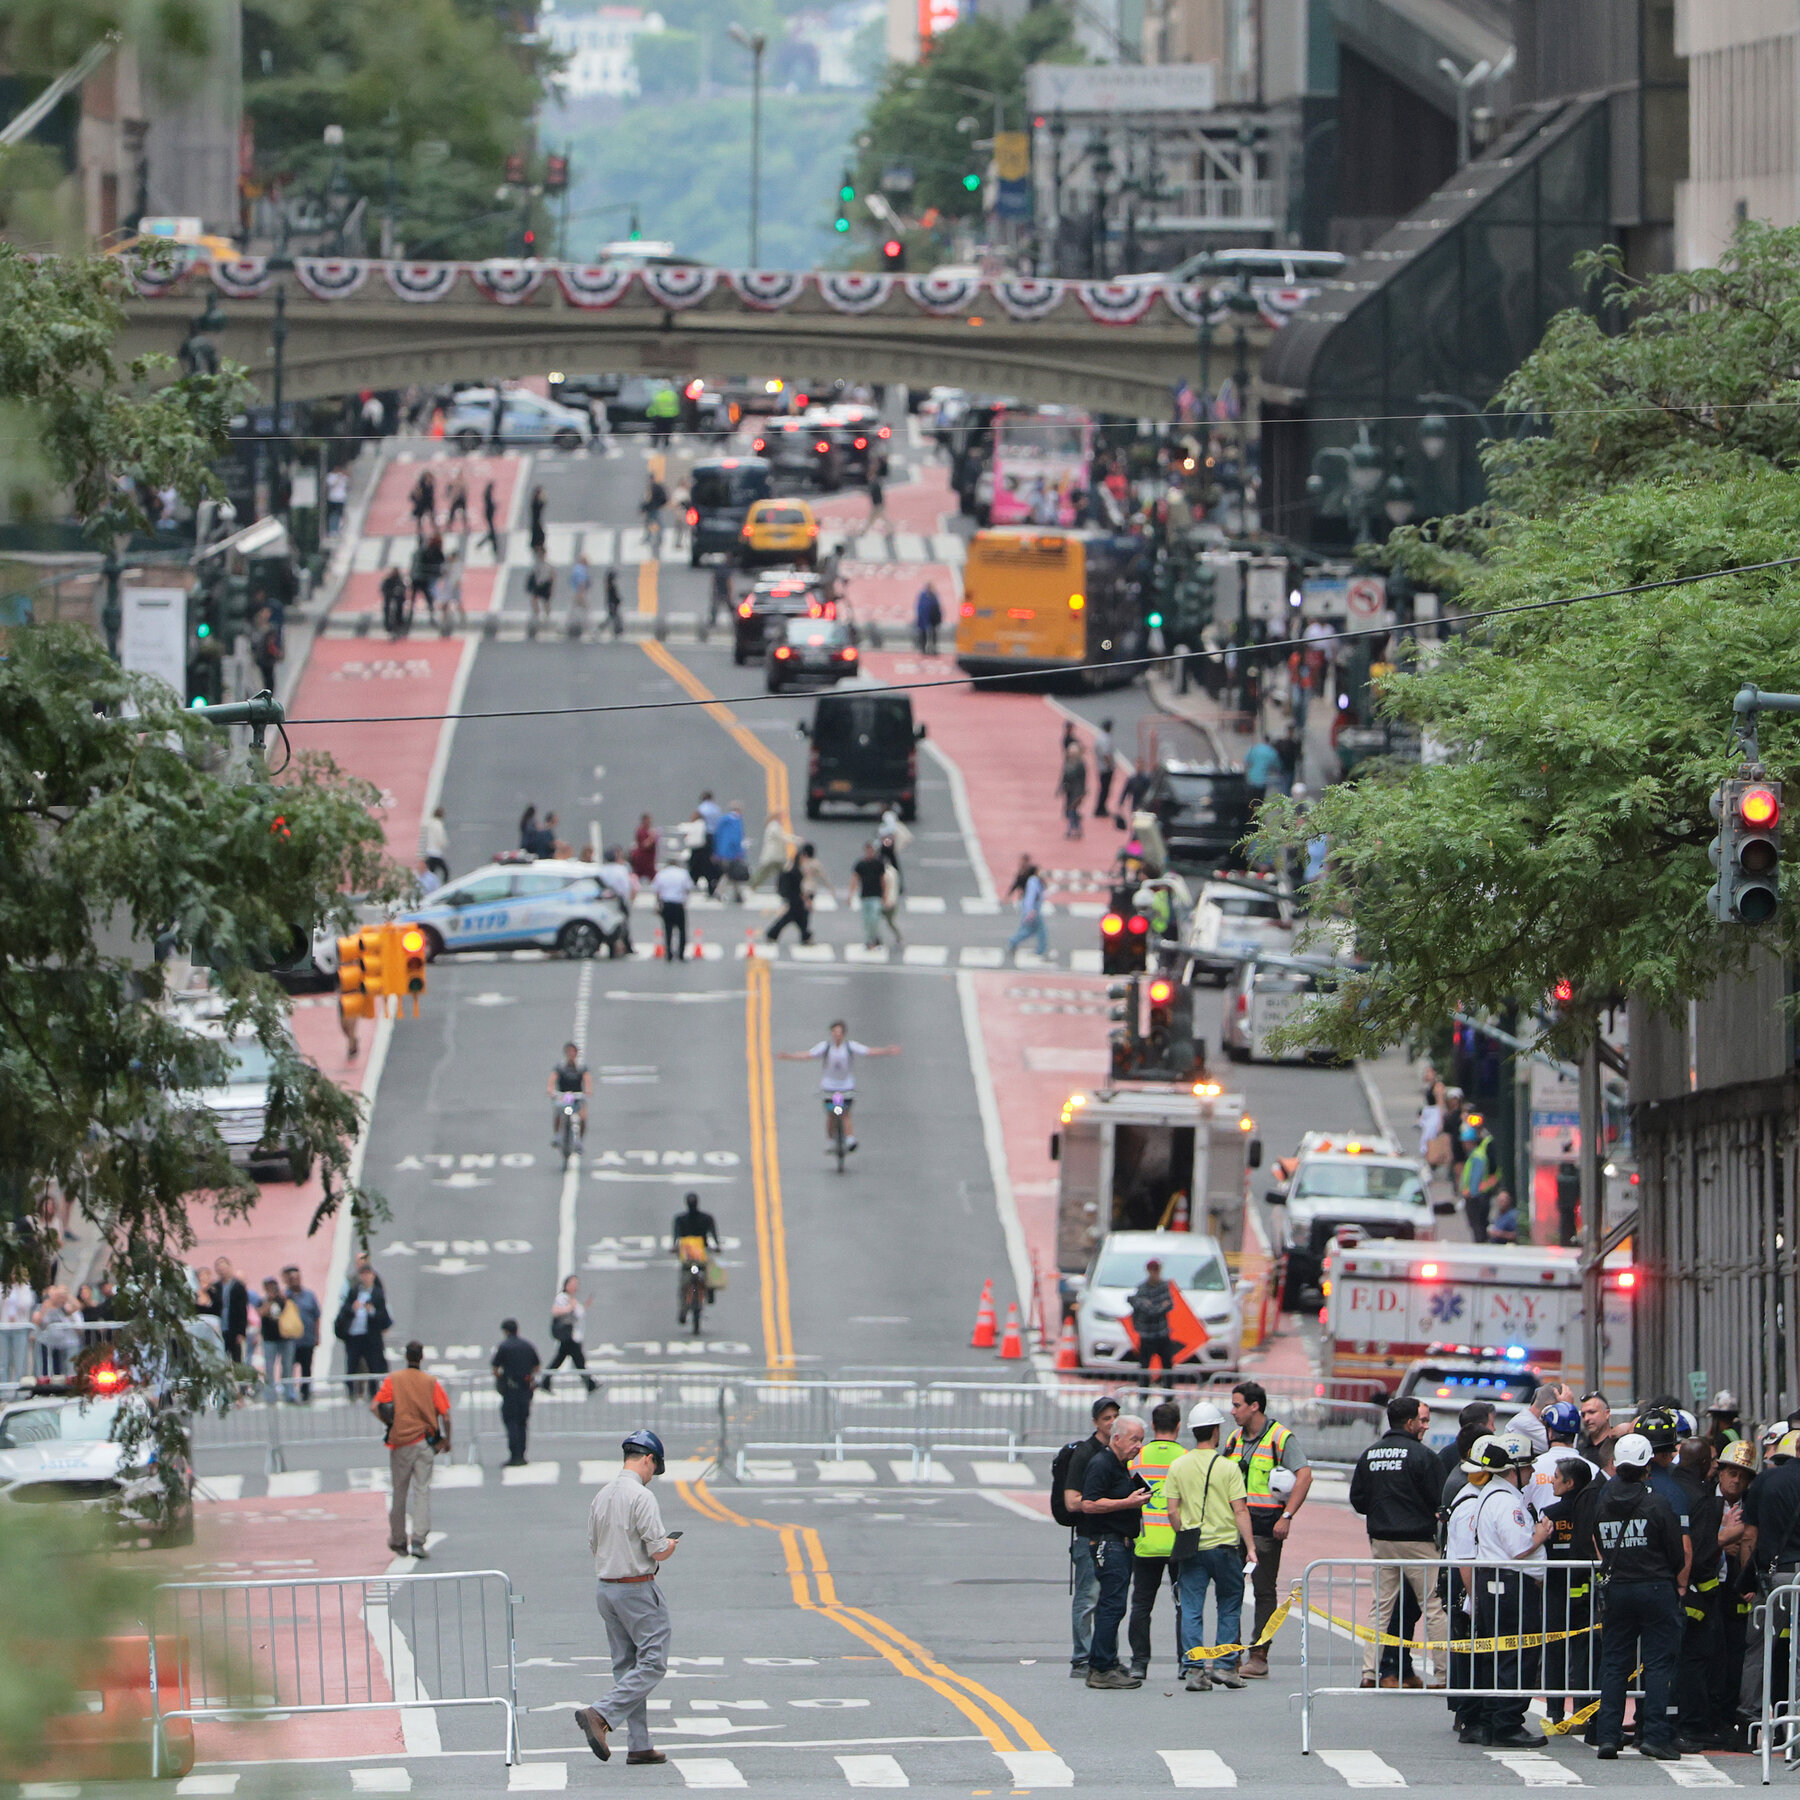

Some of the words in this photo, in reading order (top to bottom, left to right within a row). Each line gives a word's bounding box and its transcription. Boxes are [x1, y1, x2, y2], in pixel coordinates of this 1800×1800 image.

[395, 1152, 536, 1170] ONLY
[591, 1150, 741, 1167] ONLY
[381, 1240, 534, 1256] ONLY
[1352, 1287, 1405, 1313] F.D.
[1490, 1293, 1547, 1319] N.Y.
[1367, 1447, 1408, 1460] MAYOR'S
[1370, 1460, 1403, 1472] OFFICE
[1602, 1538, 1625, 1549] PRES
[1625, 1537, 1648, 1548] OFFICE
[1505, 1637, 1516, 1649] FIRE
[492, 1657, 820, 1668] ONY
